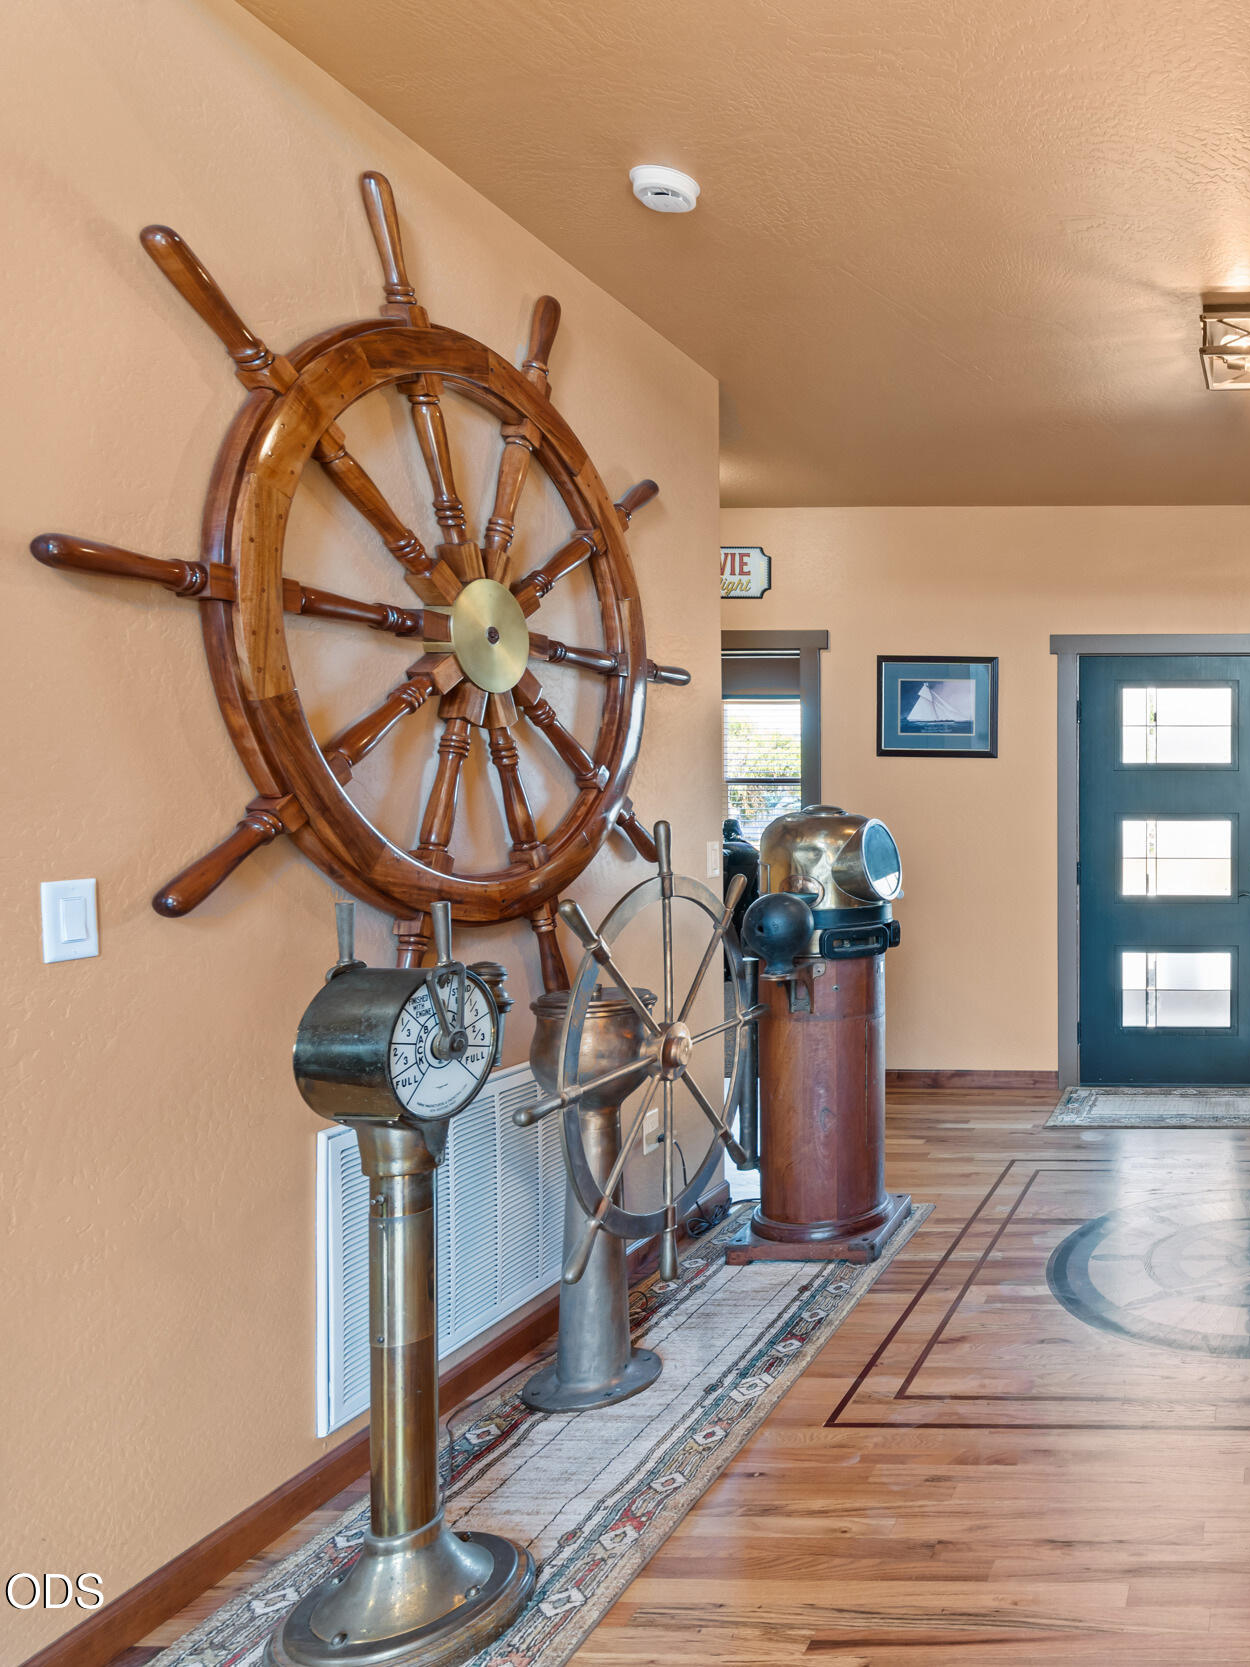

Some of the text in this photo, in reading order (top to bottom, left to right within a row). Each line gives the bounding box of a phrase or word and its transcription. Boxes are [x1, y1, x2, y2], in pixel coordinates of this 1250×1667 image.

[720, 577, 751, 596] ight
[465, 1051, 485, 1065] FULL
[395, 1075, 419, 1090] FULL
